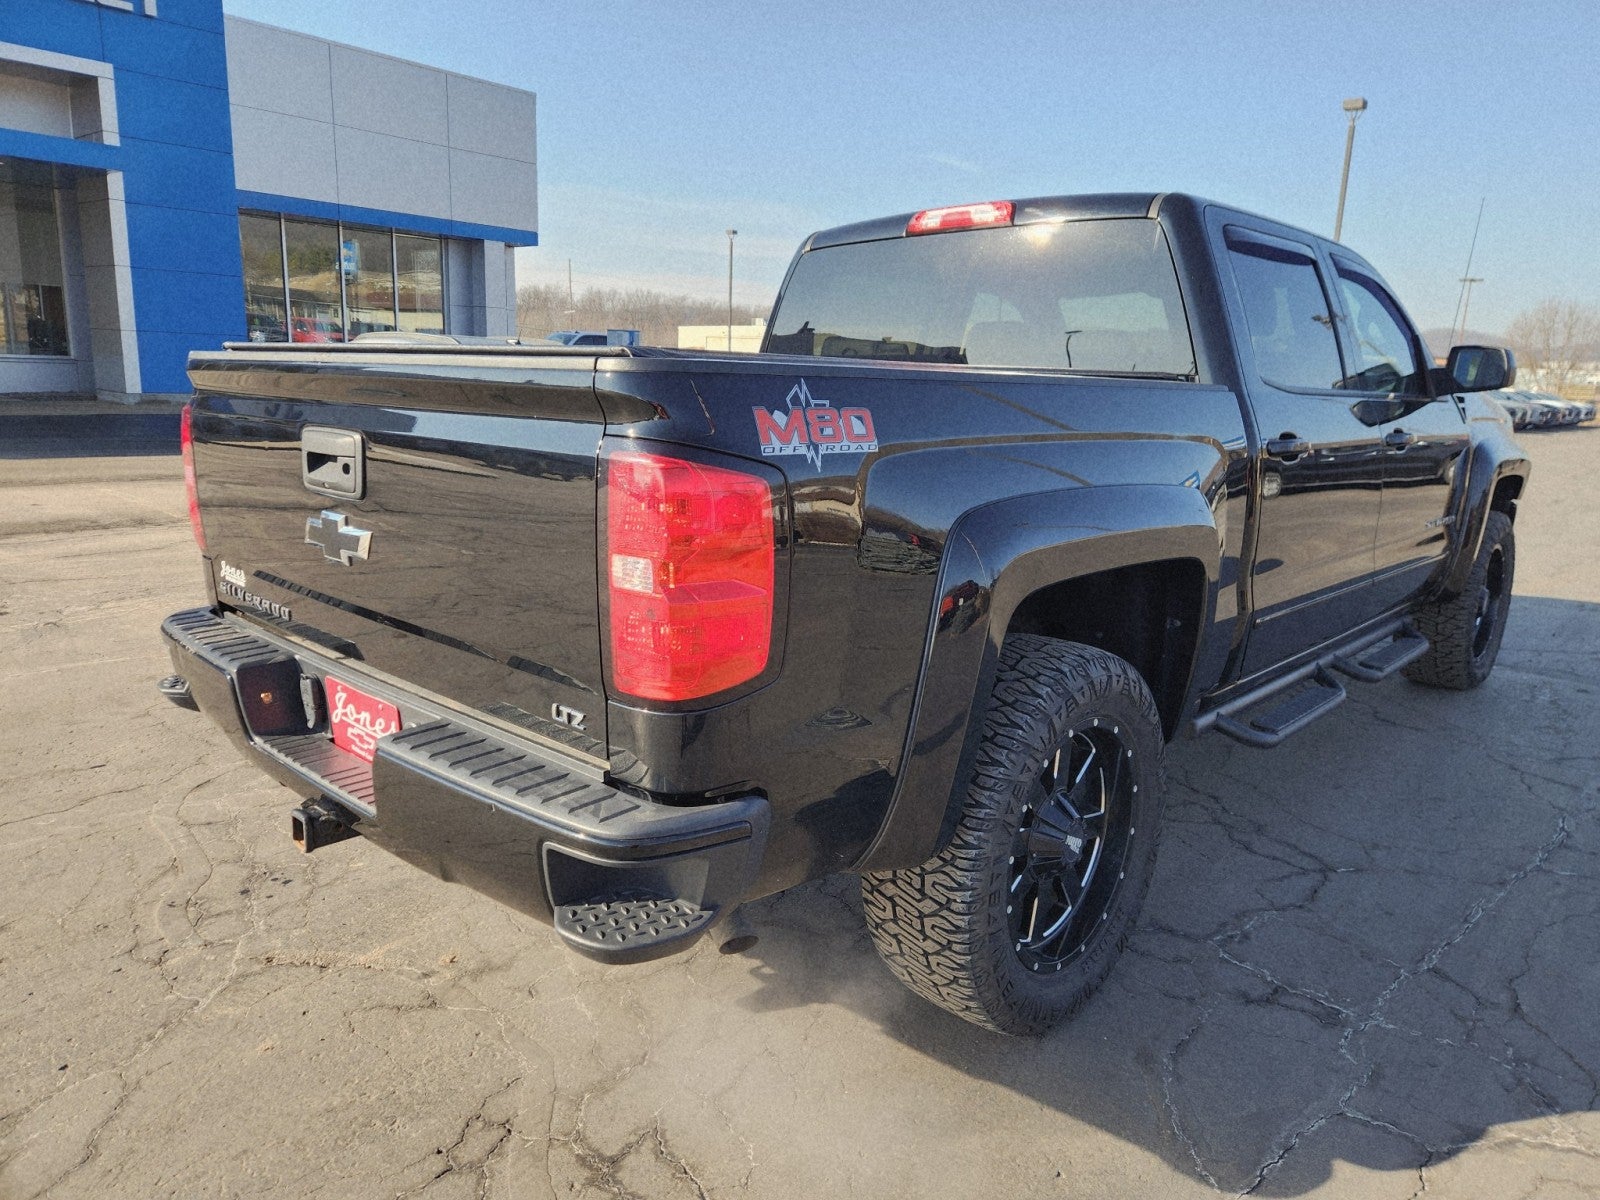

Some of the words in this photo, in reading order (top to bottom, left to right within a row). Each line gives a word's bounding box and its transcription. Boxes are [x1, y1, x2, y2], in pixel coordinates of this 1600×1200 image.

[752, 406, 877, 446] M80
[762, 445, 803, 454] OFF
[825, 444, 878, 452] ROAD
[220, 581, 292, 621] SILVERADO
[551, 702, 587, 731] LTZ
